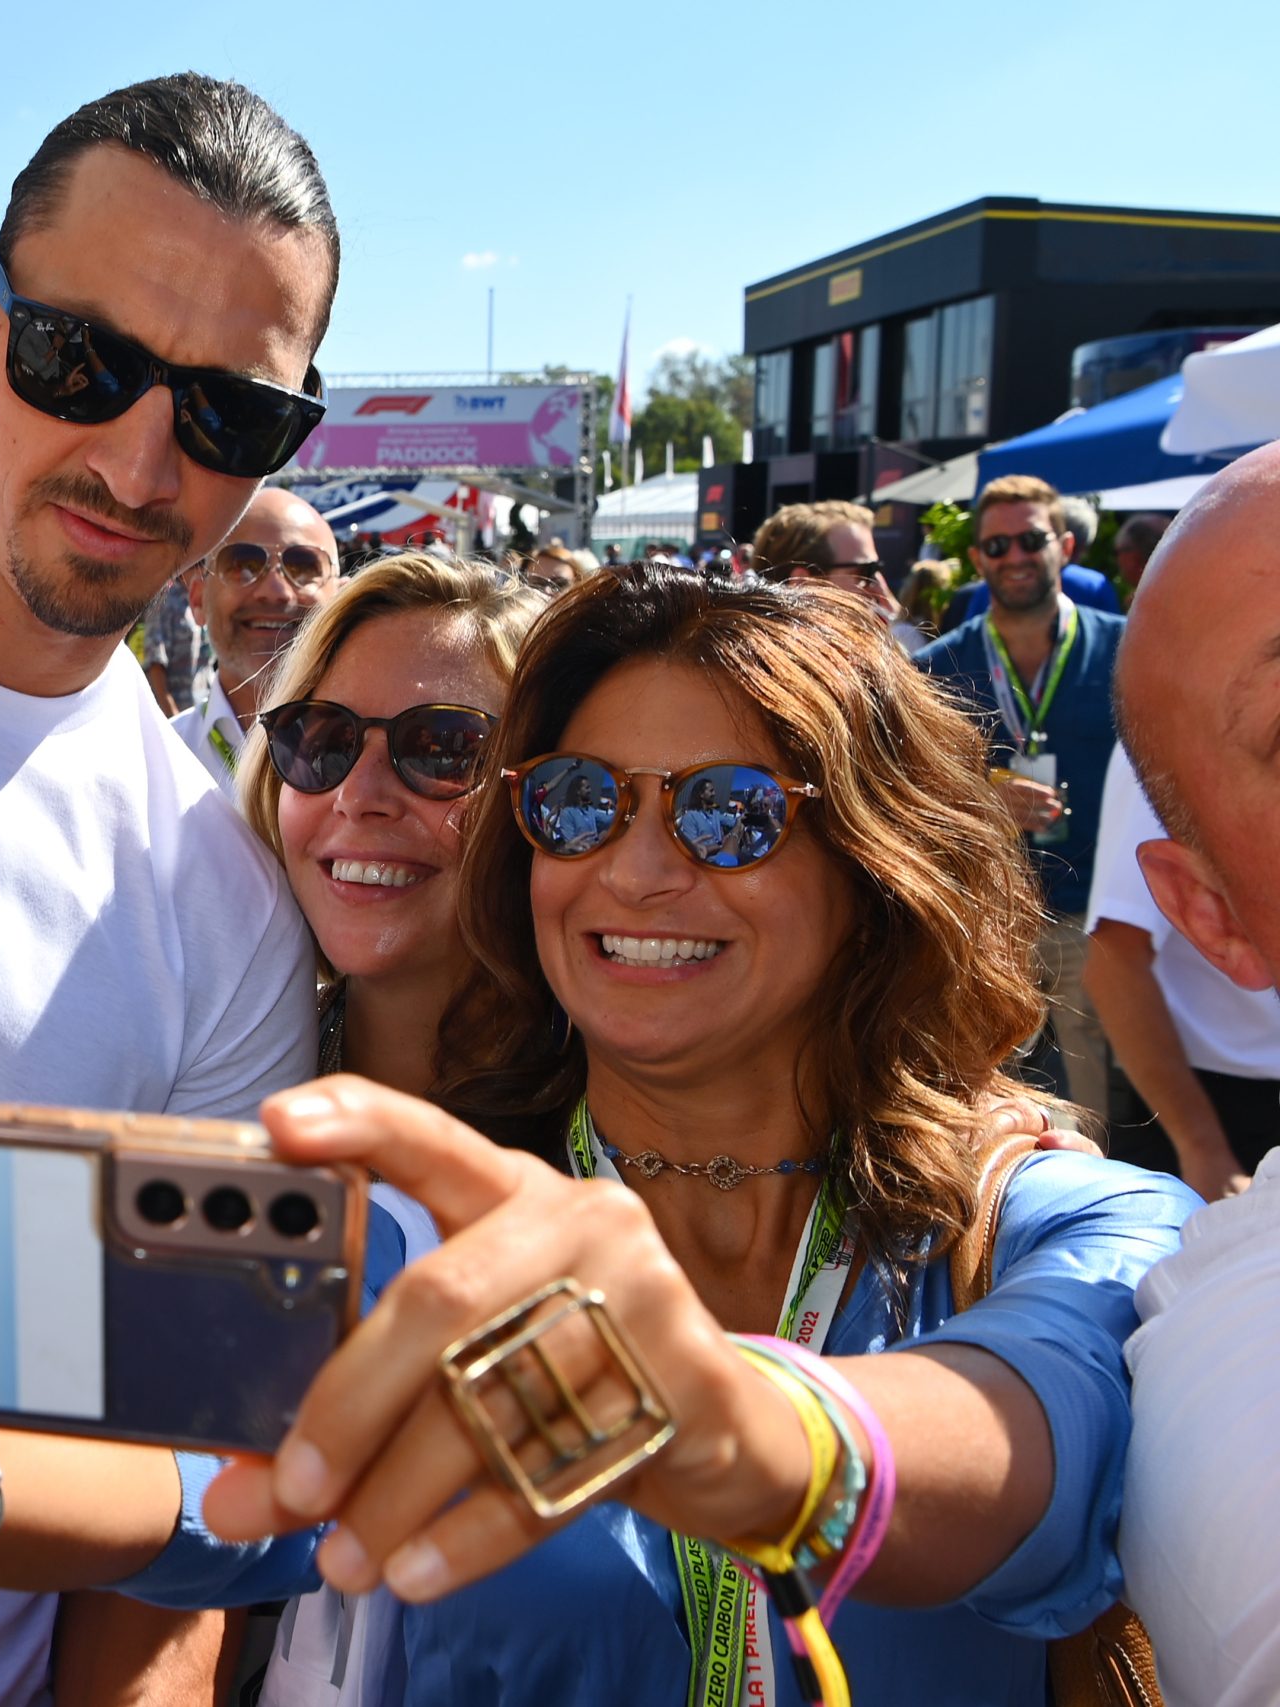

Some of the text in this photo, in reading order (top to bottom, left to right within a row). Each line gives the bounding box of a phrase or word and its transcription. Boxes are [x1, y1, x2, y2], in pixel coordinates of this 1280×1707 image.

[376, 447, 478, 463] PADDOCK
[796, 1311, 820, 1344] 2022
[688, 1534, 710, 1639] CYCLED PLAS
[745, 1585, 760, 1658] PIRELL
[706, 1556, 738, 1707] ZERO CARBON BY
